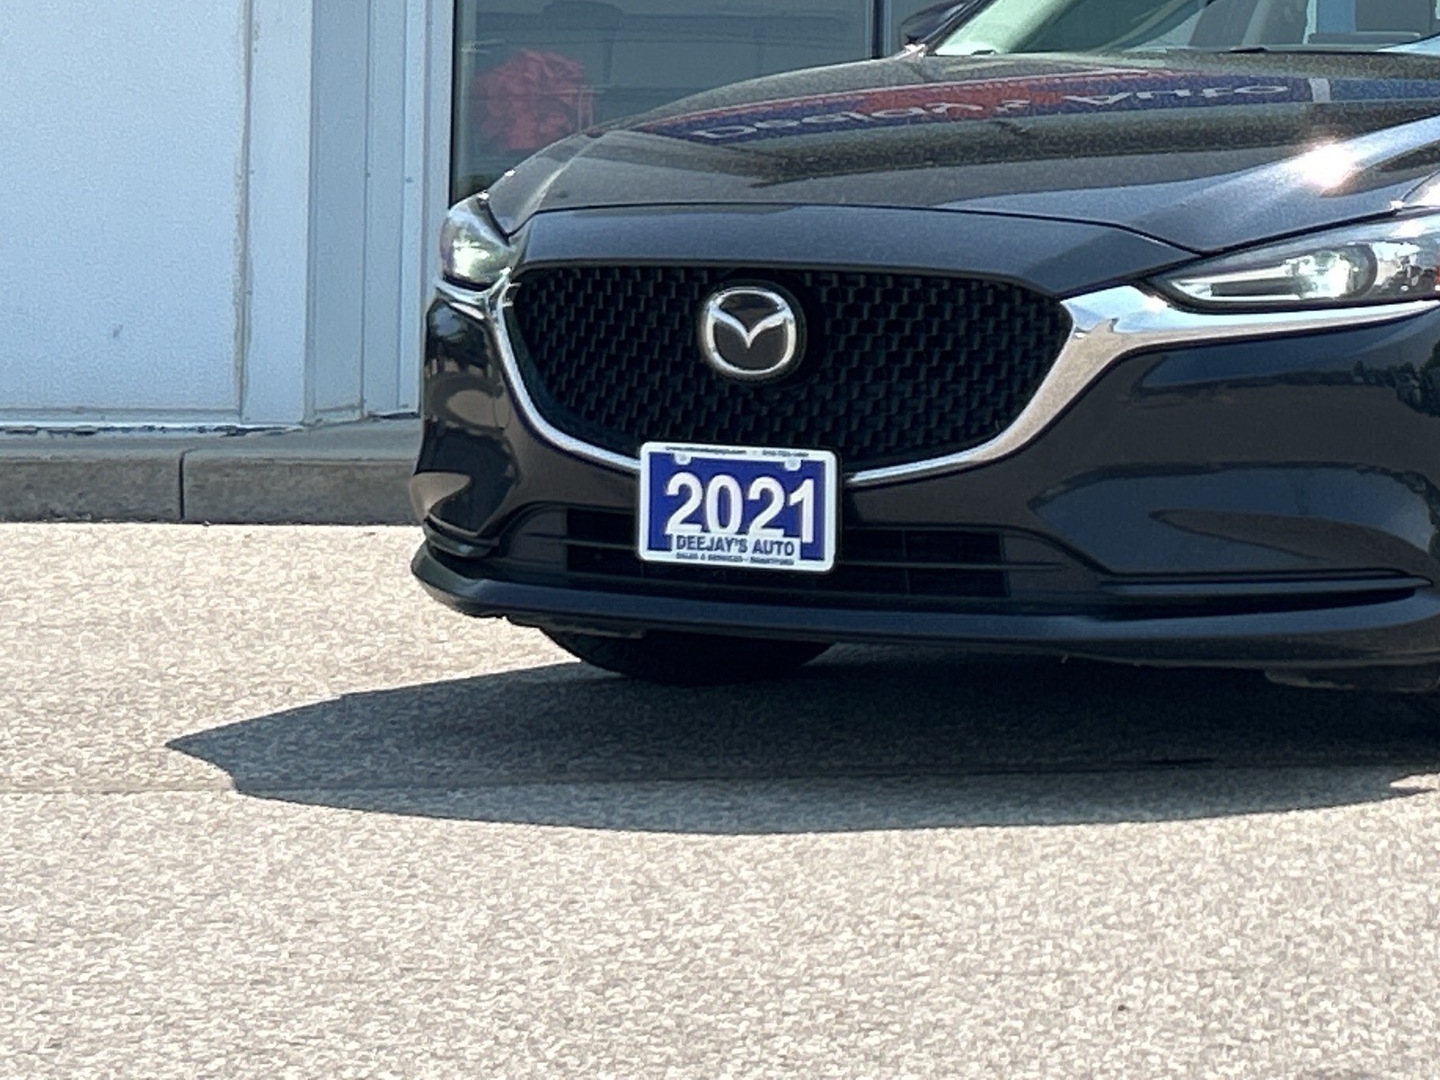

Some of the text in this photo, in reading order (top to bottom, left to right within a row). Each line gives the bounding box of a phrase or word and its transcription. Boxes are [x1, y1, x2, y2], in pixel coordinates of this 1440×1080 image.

[665, 472, 815, 544] 2021
[676, 534, 795, 557] DEEJAY'S AUTO
